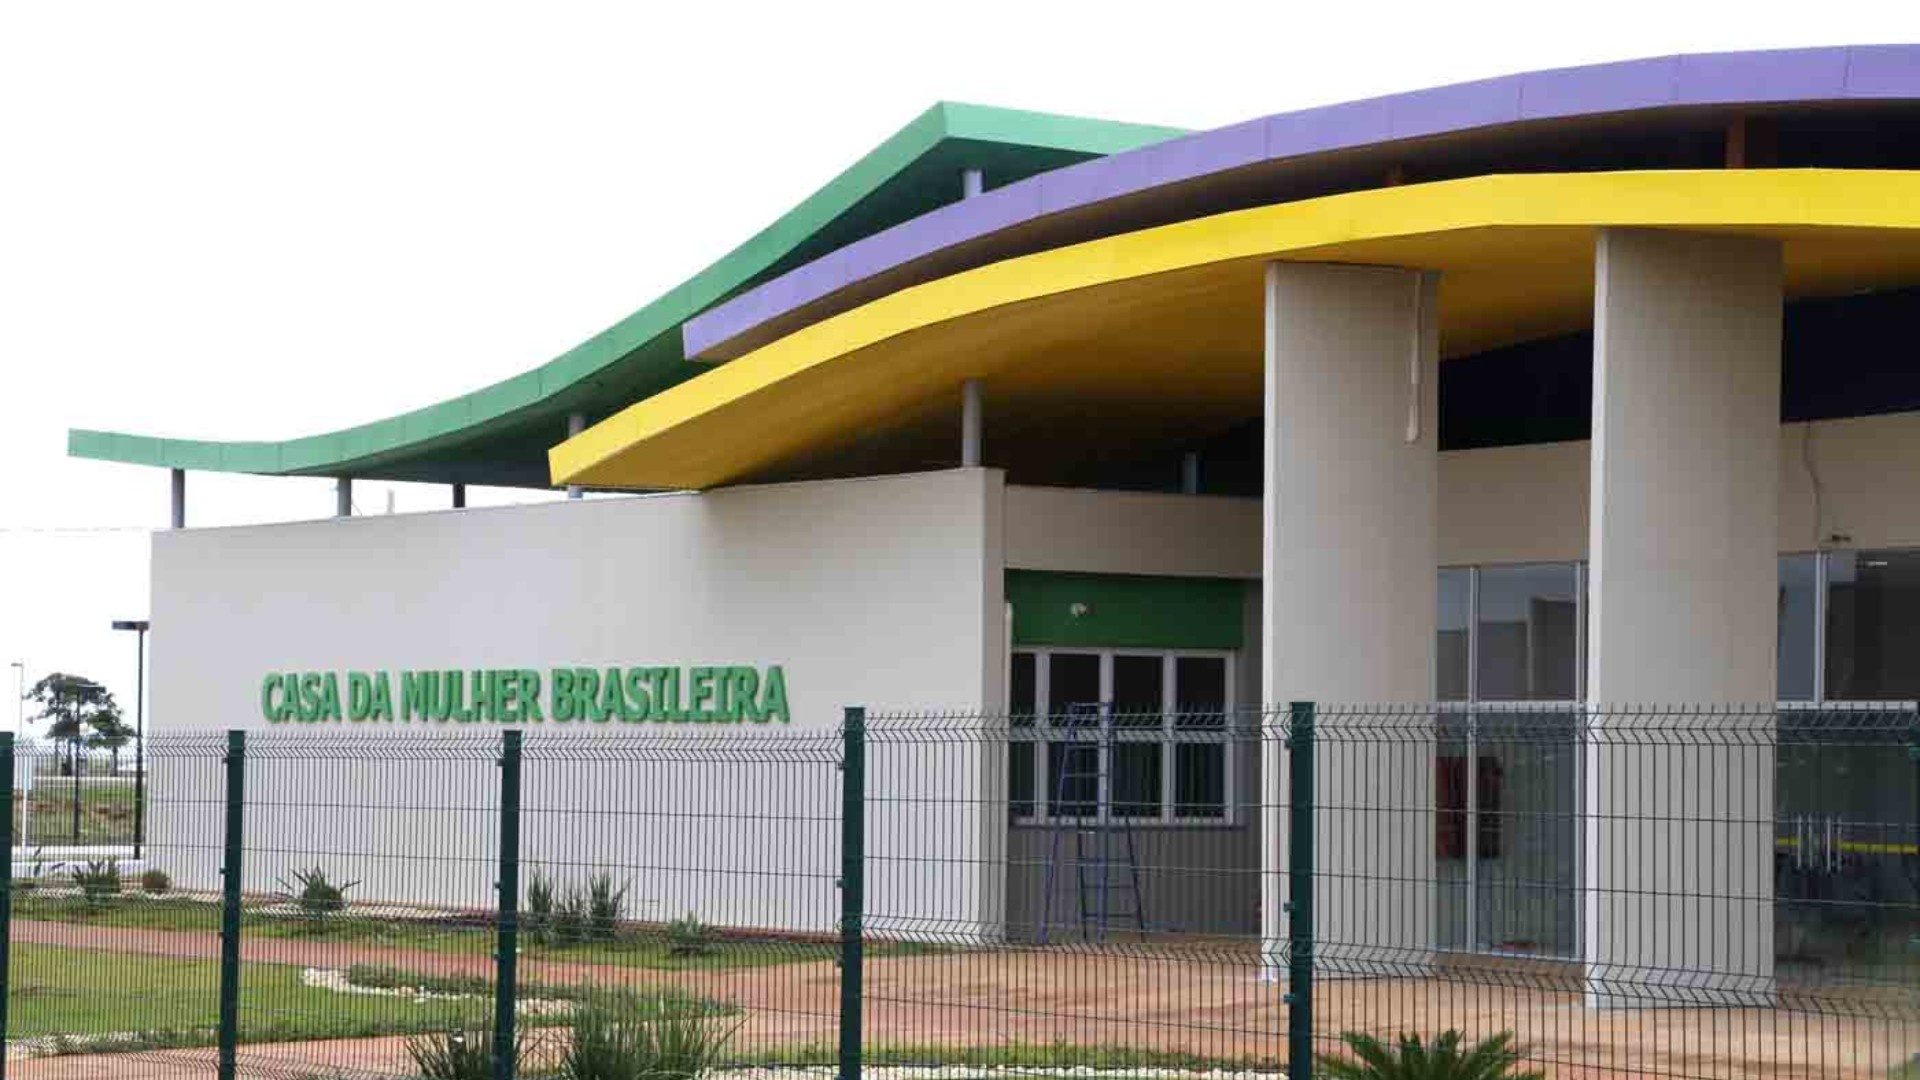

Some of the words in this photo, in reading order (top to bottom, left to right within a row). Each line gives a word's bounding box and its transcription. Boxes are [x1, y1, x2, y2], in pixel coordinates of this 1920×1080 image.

[262, 672, 341, 723] CASA
[347, 671, 392, 722] DA
[401, 669, 543, 723] MULHER
[551, 665, 791, 723] BRASILEIRA
